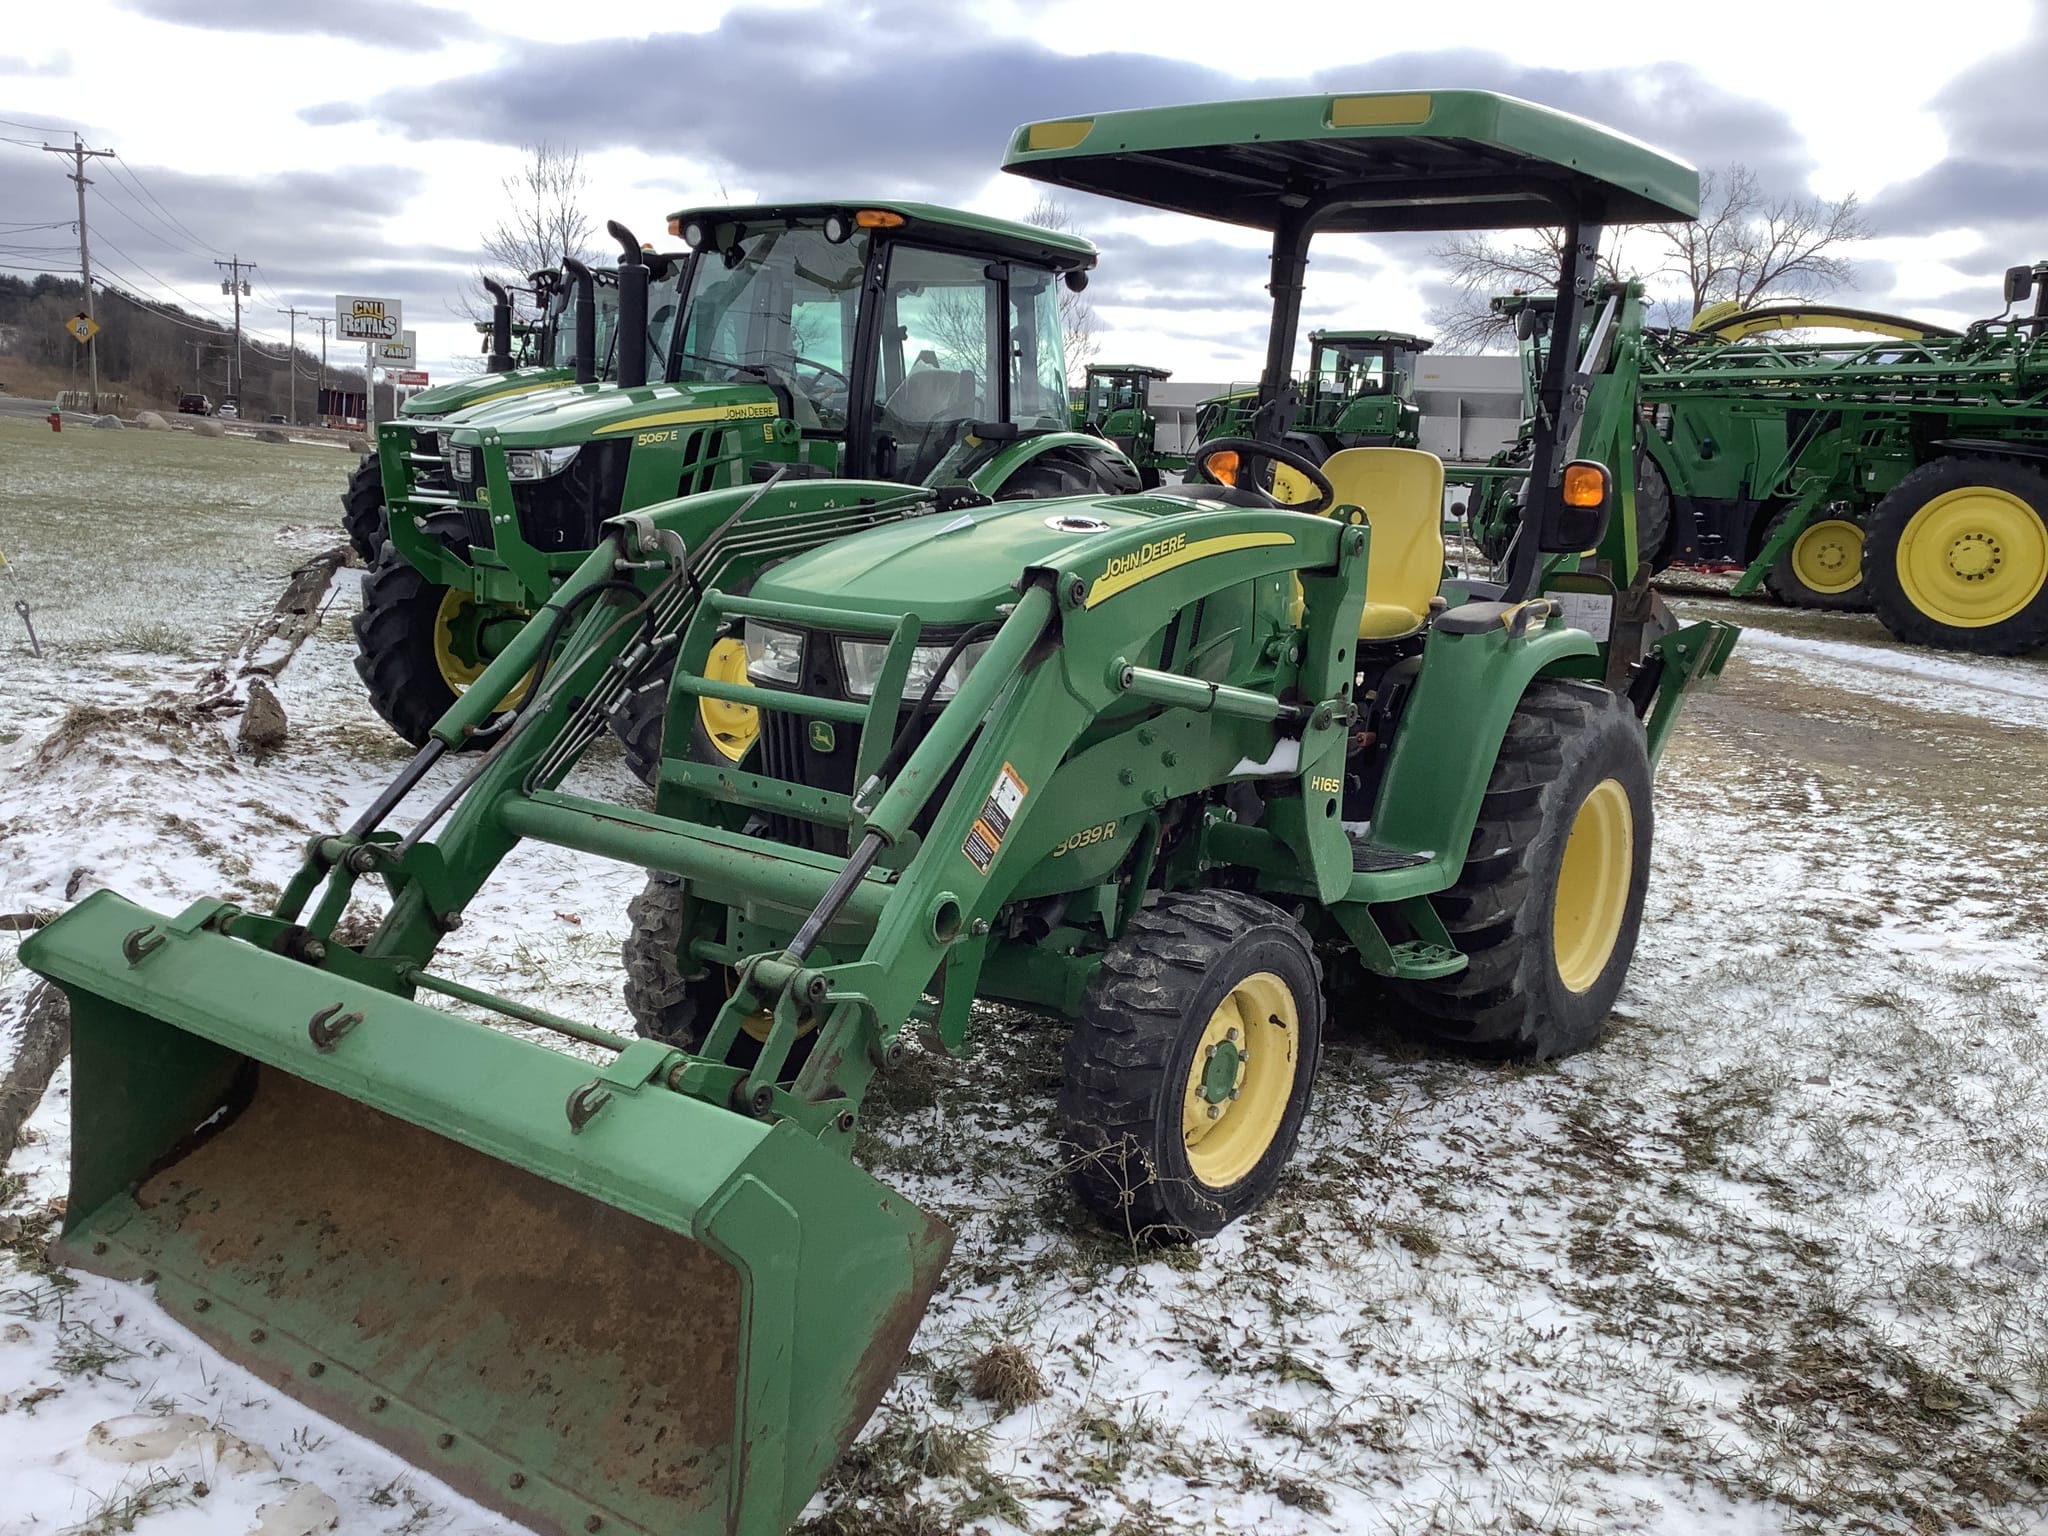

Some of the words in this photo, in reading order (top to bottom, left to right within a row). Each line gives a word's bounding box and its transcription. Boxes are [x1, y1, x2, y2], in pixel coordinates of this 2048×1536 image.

[76, 326, 88, 337] 40
[341, 313, 397, 336] RENTALS
[724, 407, 747, 420] JOHN
[748, 406, 774, 418] DEERE
[1100, 550, 1140, 581] JOHN
[1140, 532, 1186, 566] DEERE
[1311, 775, 1341, 793] H165
